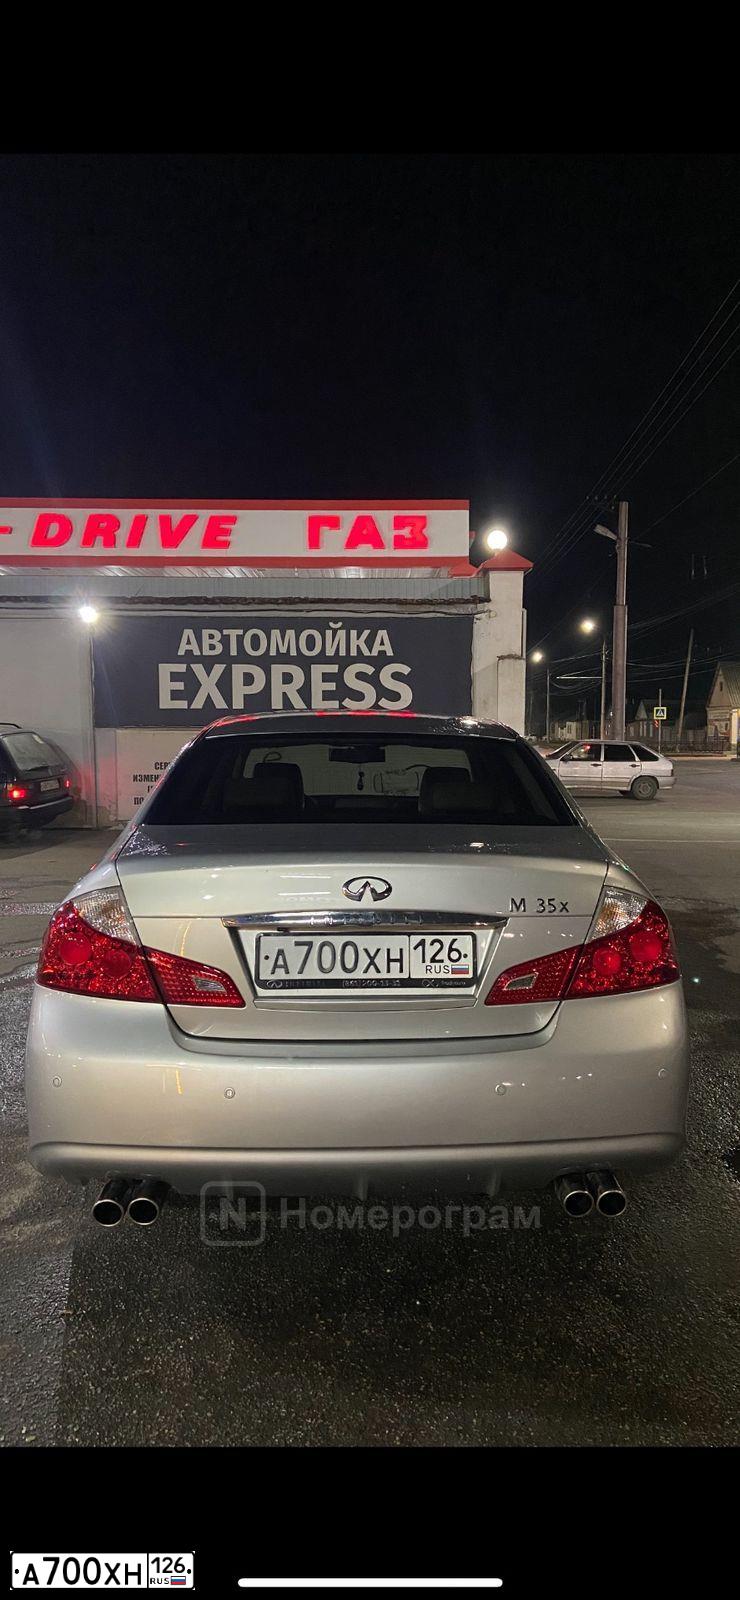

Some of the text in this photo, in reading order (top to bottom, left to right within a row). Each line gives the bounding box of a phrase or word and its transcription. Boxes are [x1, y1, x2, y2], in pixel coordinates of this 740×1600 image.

[307, 514, 429, 550] ГАЗ
[177, 621, 394, 657] АВТОМОЙКА
[158, 663, 413, 709] EXPRESS
[133, 774, 161, 782] ИЗМЕН
[154, 762, 170, 770] СЕР
[510, 897, 526, 912] M
[270, 940, 404, 975] А700ХН
[413, 938, 462, 964] 126
[425, 964, 450, 974] RUS
